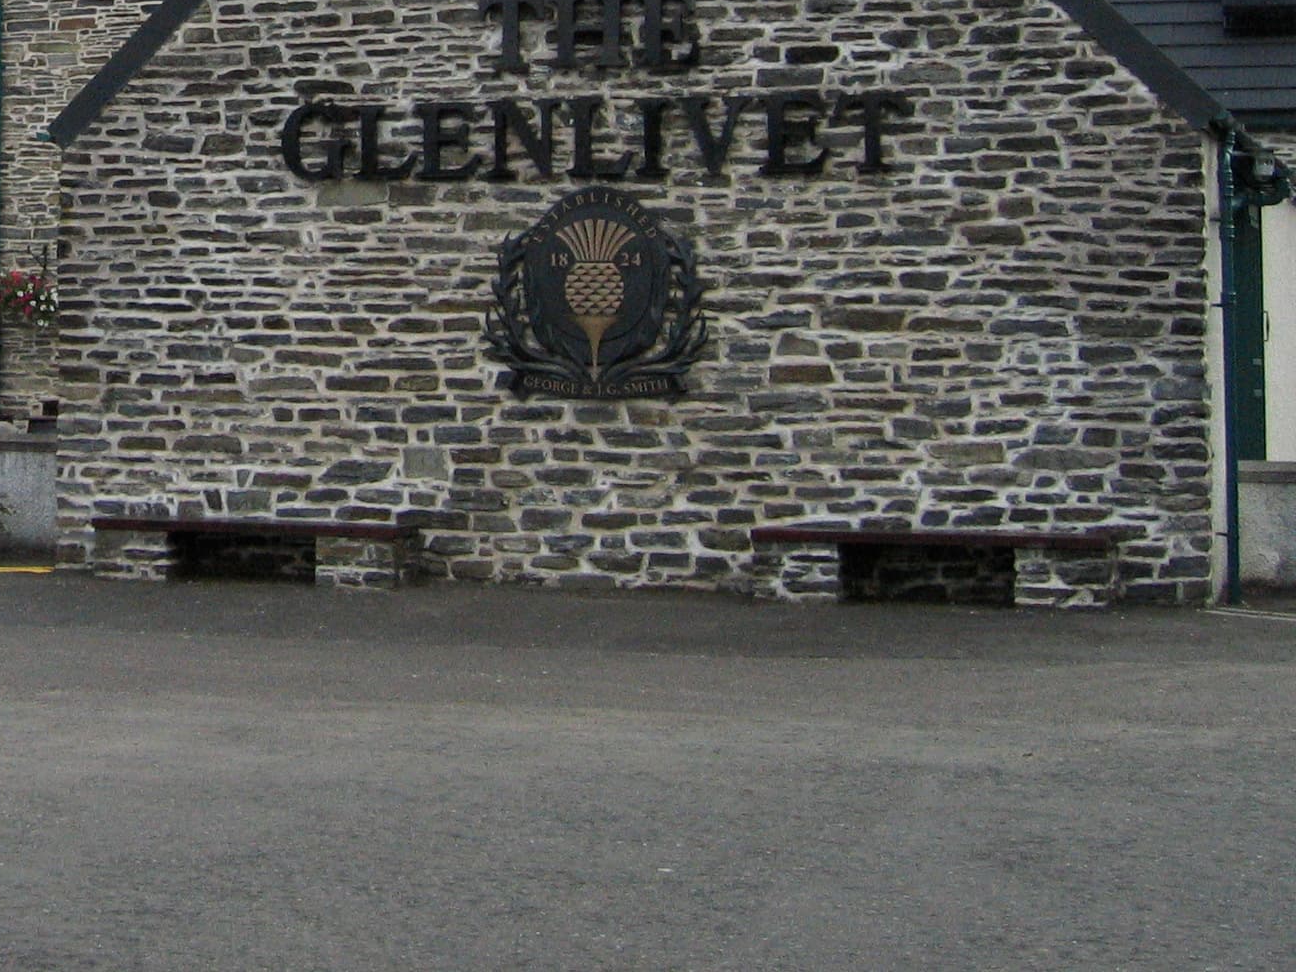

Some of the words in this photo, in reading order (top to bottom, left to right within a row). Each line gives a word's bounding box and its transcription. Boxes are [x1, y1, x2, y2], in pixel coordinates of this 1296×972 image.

[280, 91, 913, 181] GLENLIVET
[532, 193, 658, 243] ESTABLISHED
[551, 252, 569, 267] 18
[621, 252, 642, 267] 24
[523, 375, 577, 395] GEORGE
[582, 385, 593, 395] &
[624, 378, 670, 394] SMITH
